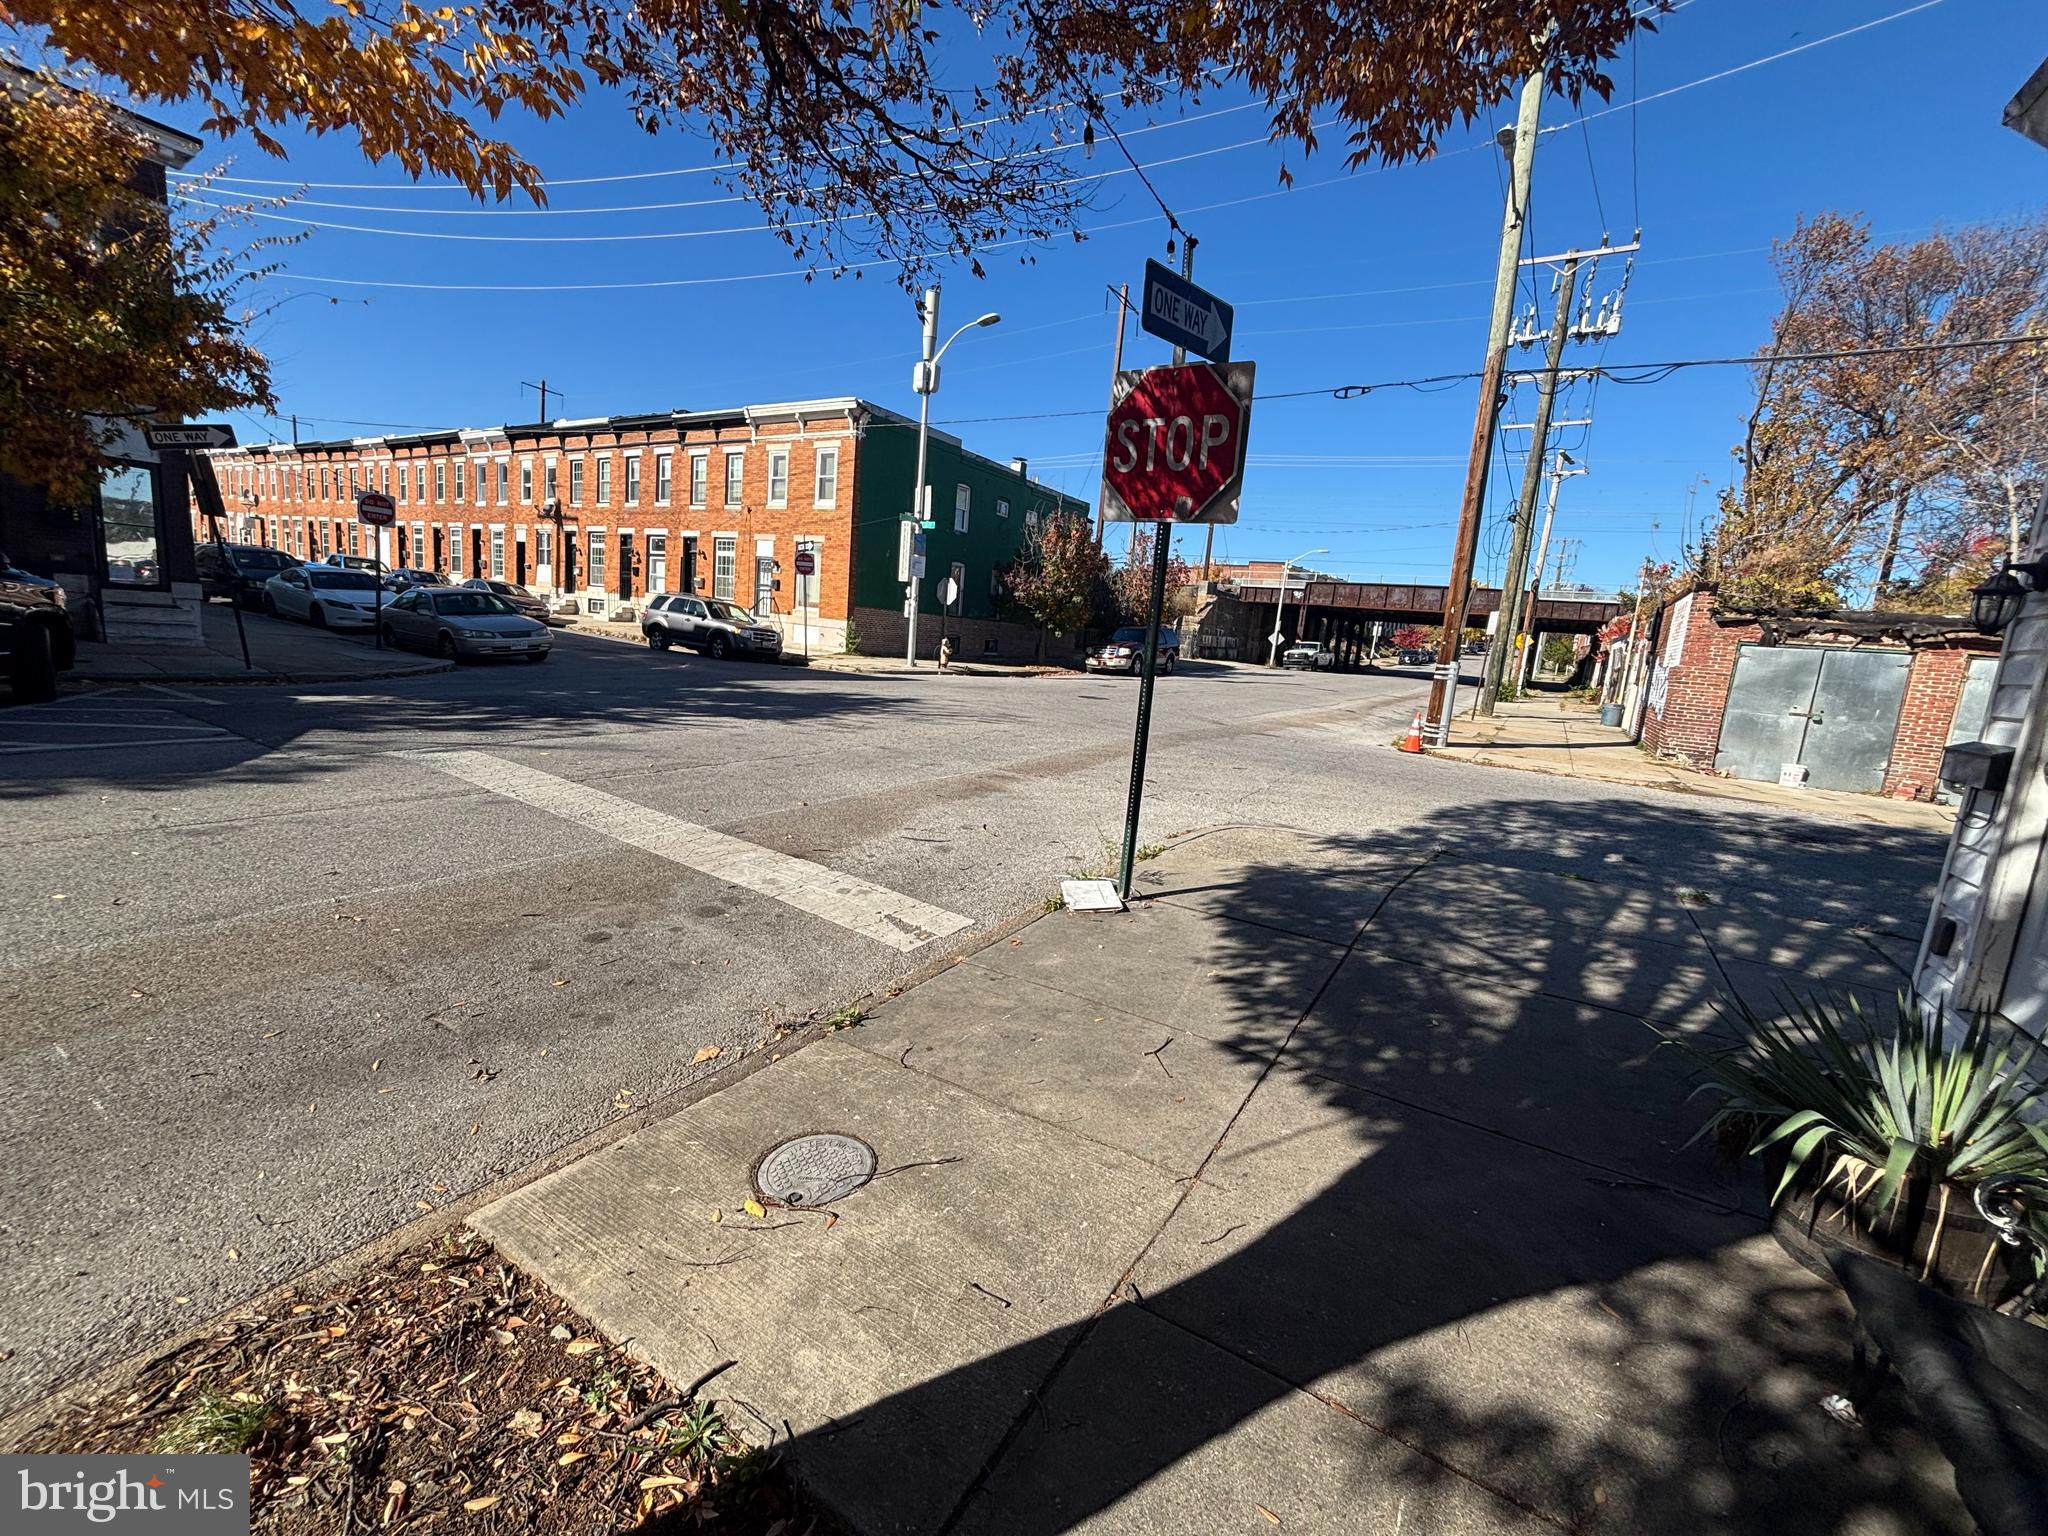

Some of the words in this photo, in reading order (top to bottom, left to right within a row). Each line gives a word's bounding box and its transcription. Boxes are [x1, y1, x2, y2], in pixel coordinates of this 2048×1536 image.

[1154, 287, 1180, 323] ONE
[1184, 302, 1208, 336] WAY
[154, 432, 180, 442] ONE
[183, 432, 208, 442] WAY
[1113, 414, 1230, 473] STOP
[367, 512, 388, 520] ENTER
